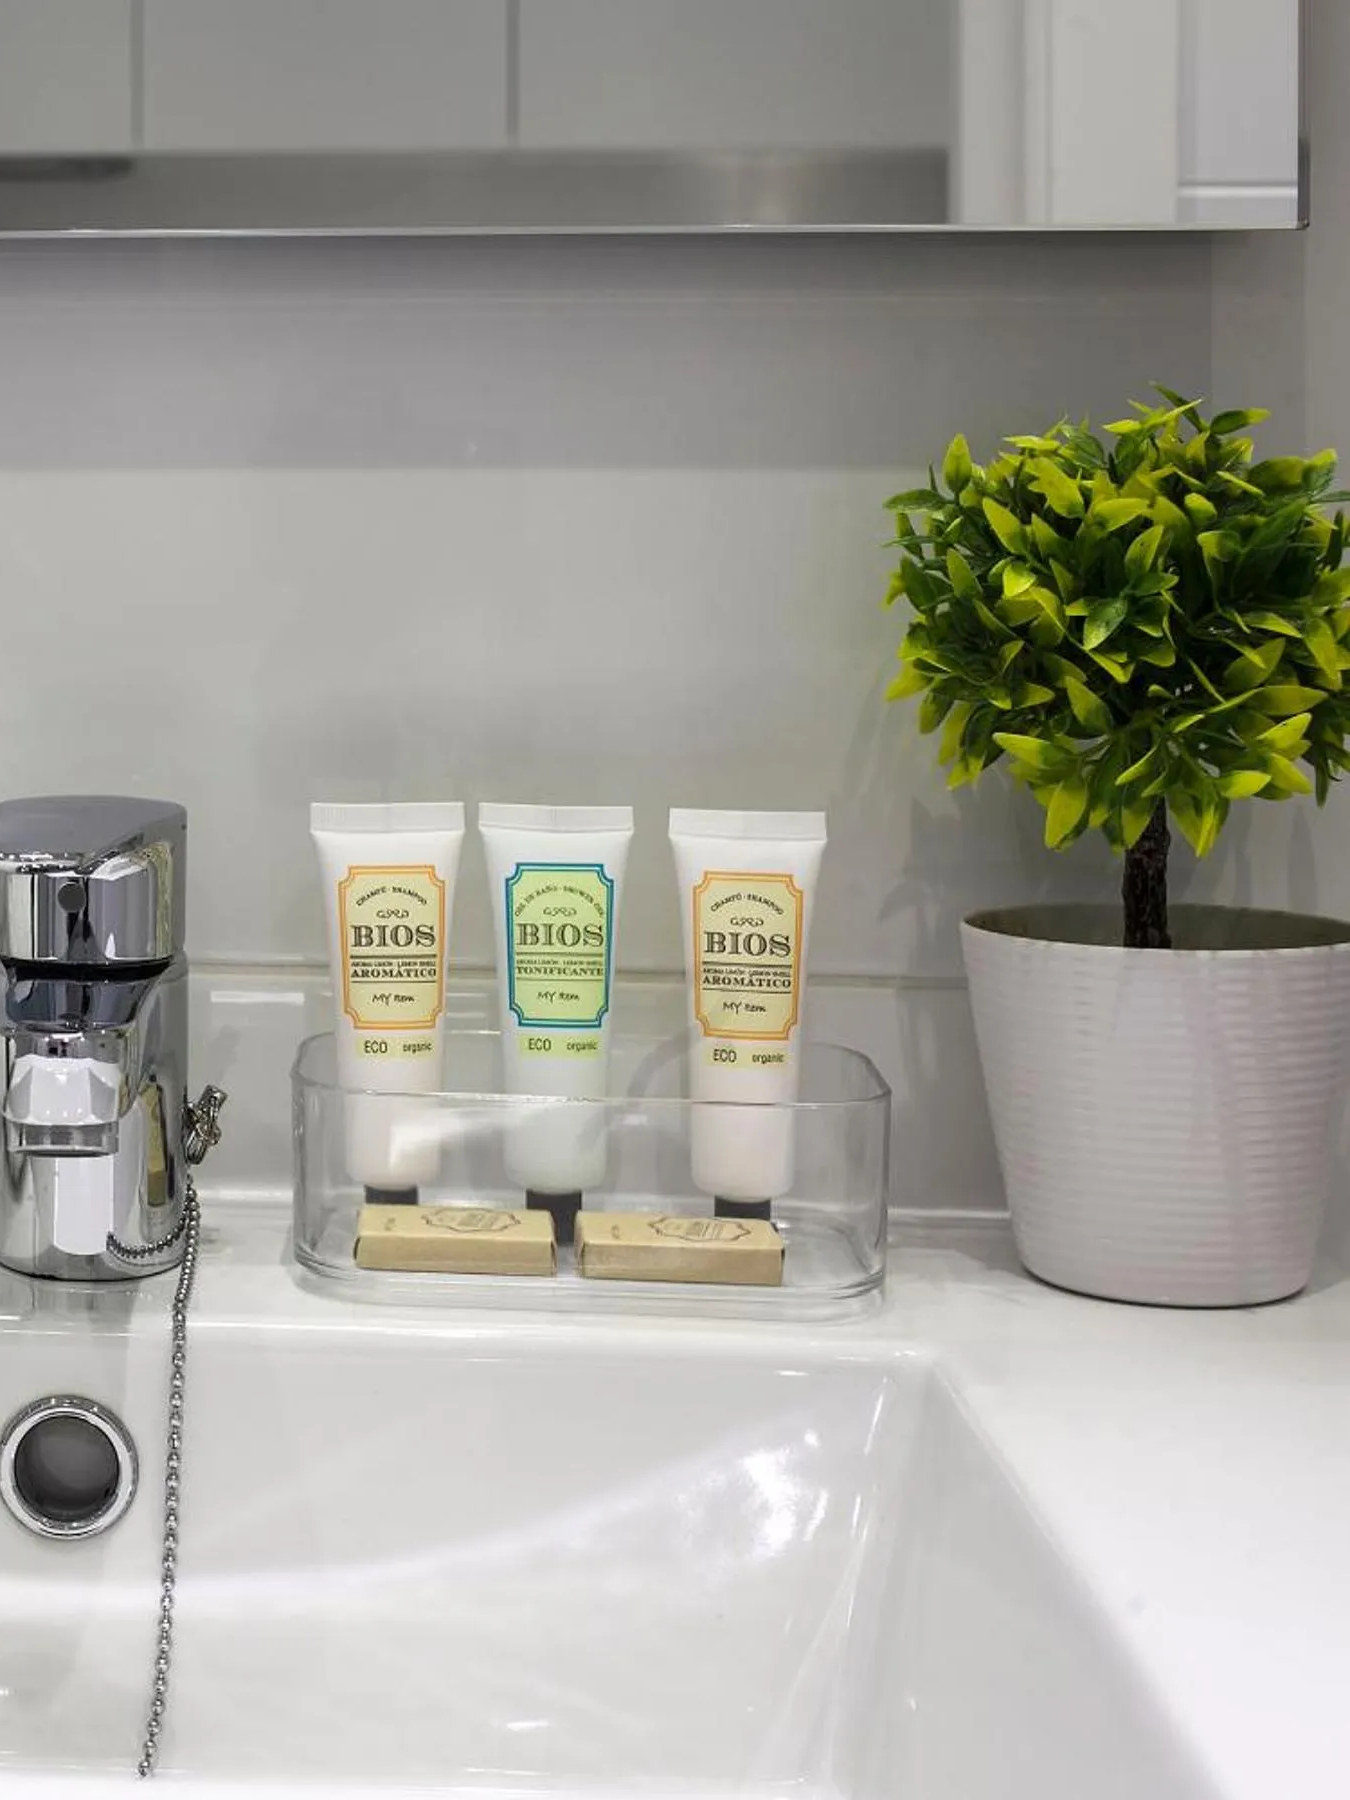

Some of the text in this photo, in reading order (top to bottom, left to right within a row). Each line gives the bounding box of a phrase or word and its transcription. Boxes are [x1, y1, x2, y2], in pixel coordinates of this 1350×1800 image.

[350, 924, 436, 948] BIOS
[516, 922, 604, 948] BIOS
[703, 930, 791, 958] BIOS
[516, 966, 605, 976] TONIFICANTE
[364, 1040, 432, 1053] ECO organic
[528, 1038, 598, 1052] ECO organic
[713, 1049, 785, 1064] ECO organic
